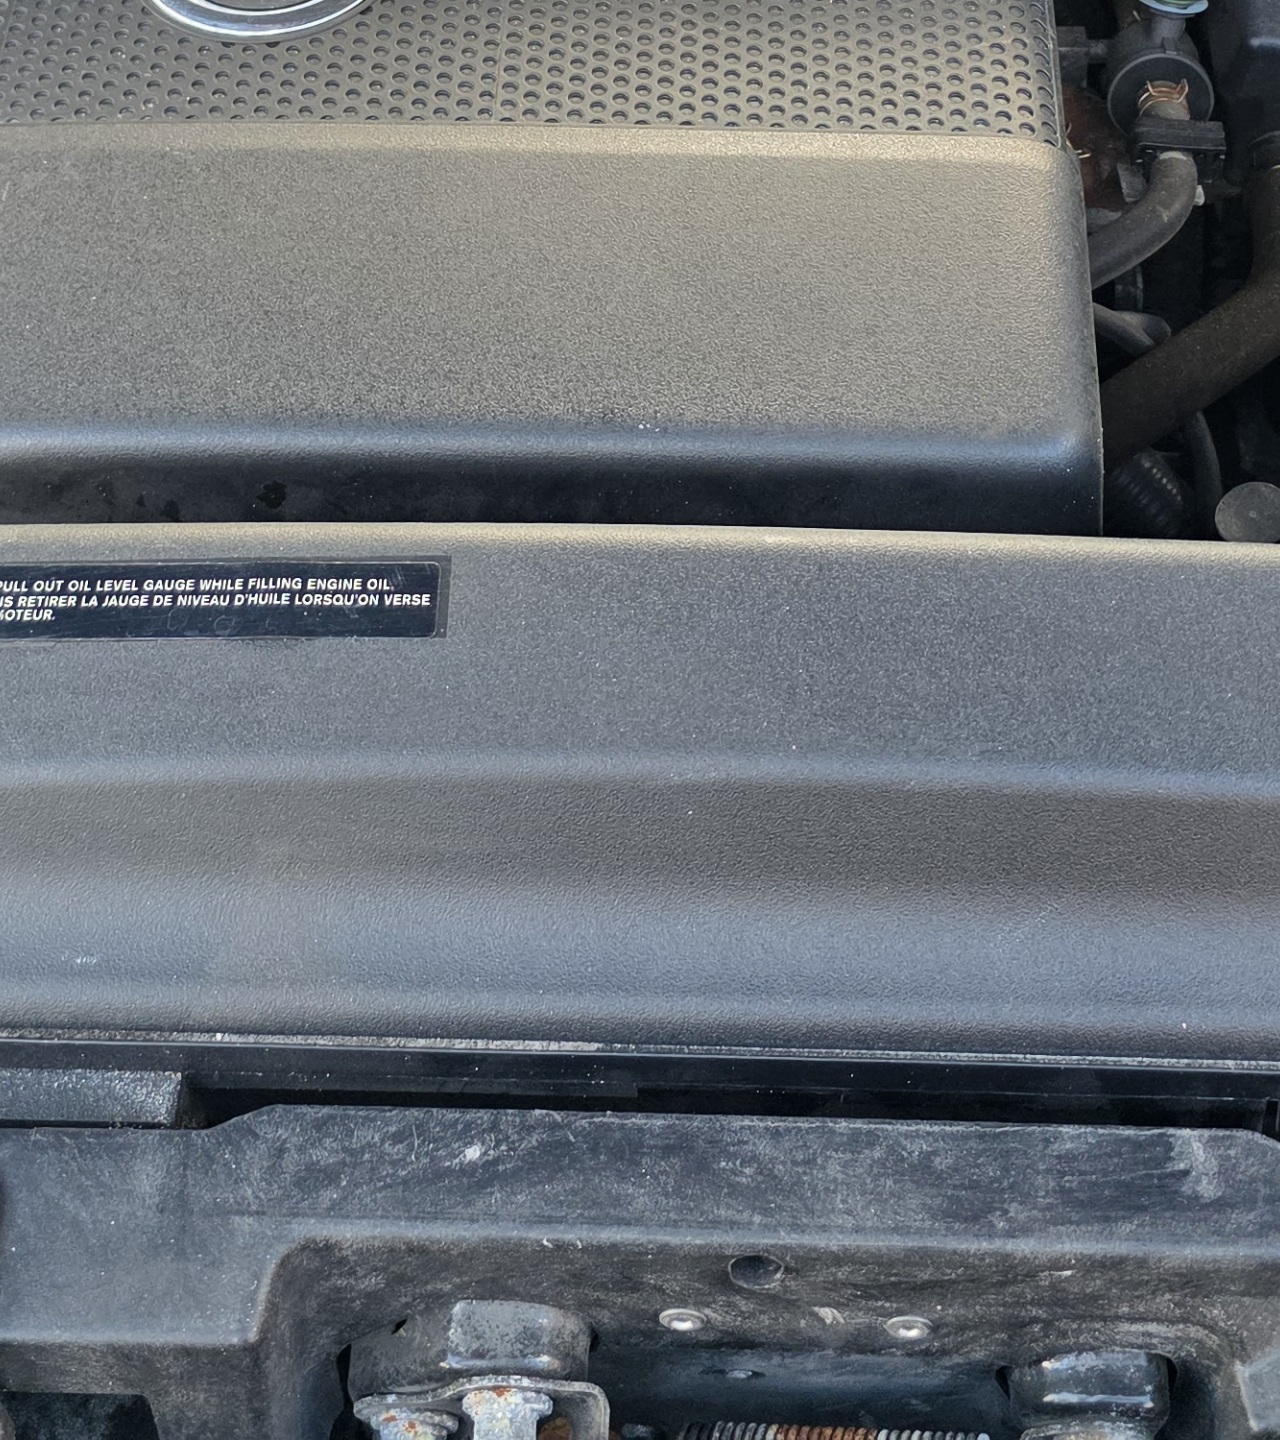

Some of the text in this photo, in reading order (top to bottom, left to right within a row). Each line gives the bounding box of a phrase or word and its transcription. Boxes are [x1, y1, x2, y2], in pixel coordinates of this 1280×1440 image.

[33, 580, 65, 593] OUT
[67, 580, 92, 592] OIL
[96, 579, 139, 592] LEVEL
[143, 579, 196, 592] GAUGE
[199, 578, 244, 591] WHILE
[247, 577, 303, 590] FILLING
[306, 578, 363, 591] ENGINE
[366, 578, 395, 591] OIL.
[17, 595, 77, 608] RETIRER
[80, 595, 99, 607] LA
[102, 594, 149, 607] JAUGE
[152, 594, 173, 606] DE
[176, 593, 230, 607] NIVEAU
[234, 592, 291, 606] D'HUILE
[294, 593, 380, 607] LORSQU'ON
[384, 593, 431, 606] VERSE
